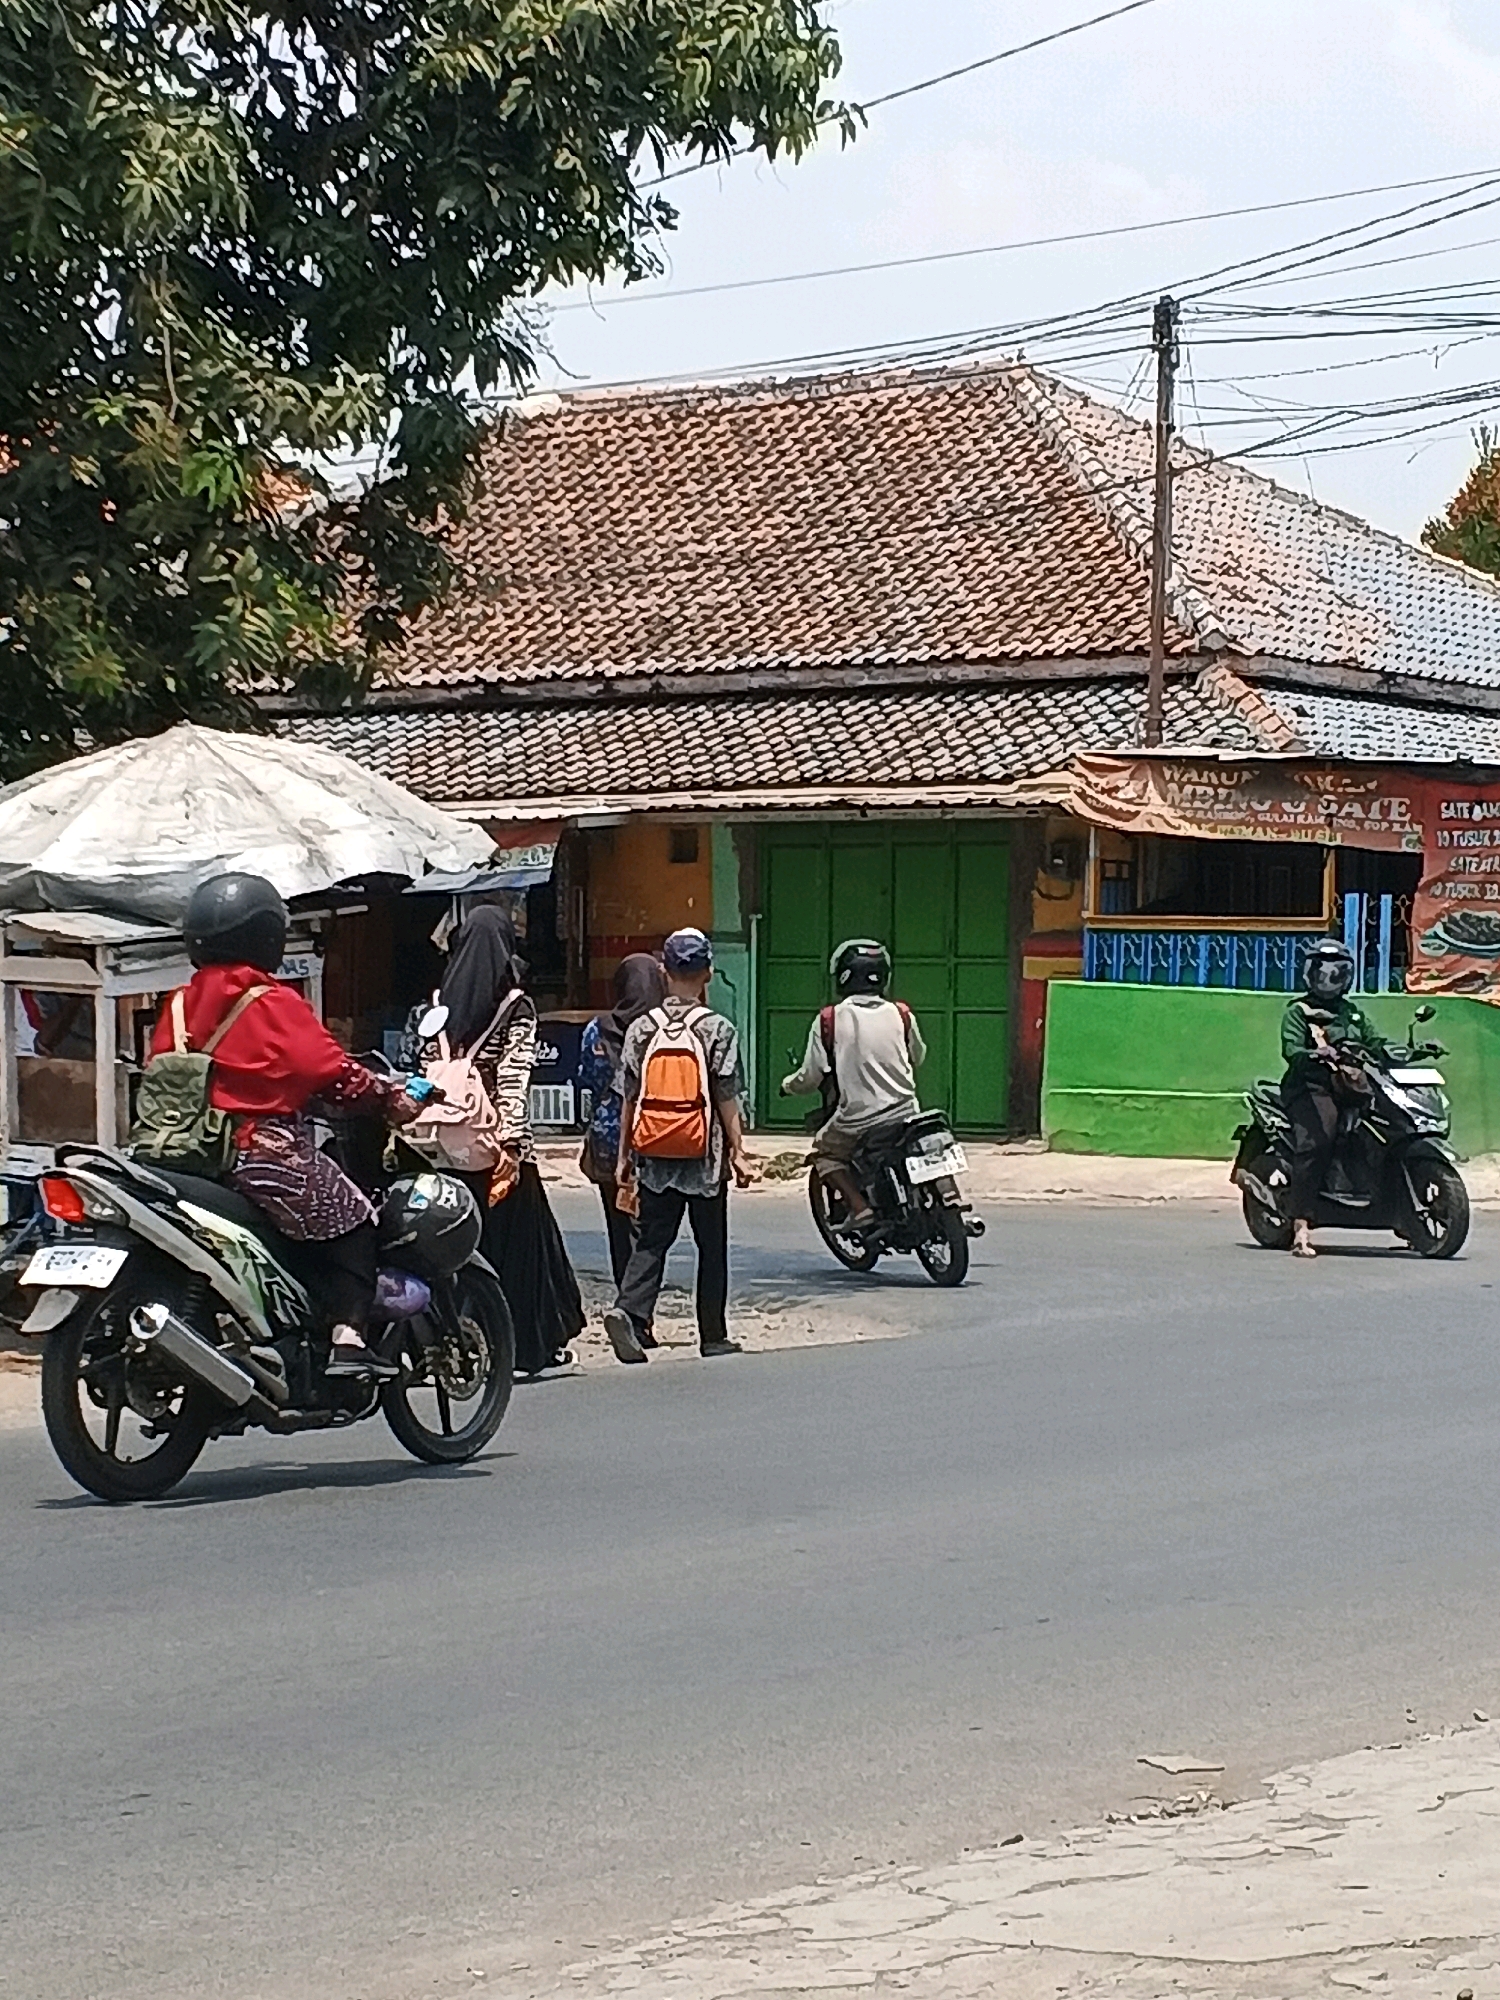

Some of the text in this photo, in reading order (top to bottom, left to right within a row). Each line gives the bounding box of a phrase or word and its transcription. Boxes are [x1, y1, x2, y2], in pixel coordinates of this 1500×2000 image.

[1162, 763, 1262, 786] WARUN
[1317, 794, 1412, 821] SATE
[1440, 801, 1470, 819] SATE
